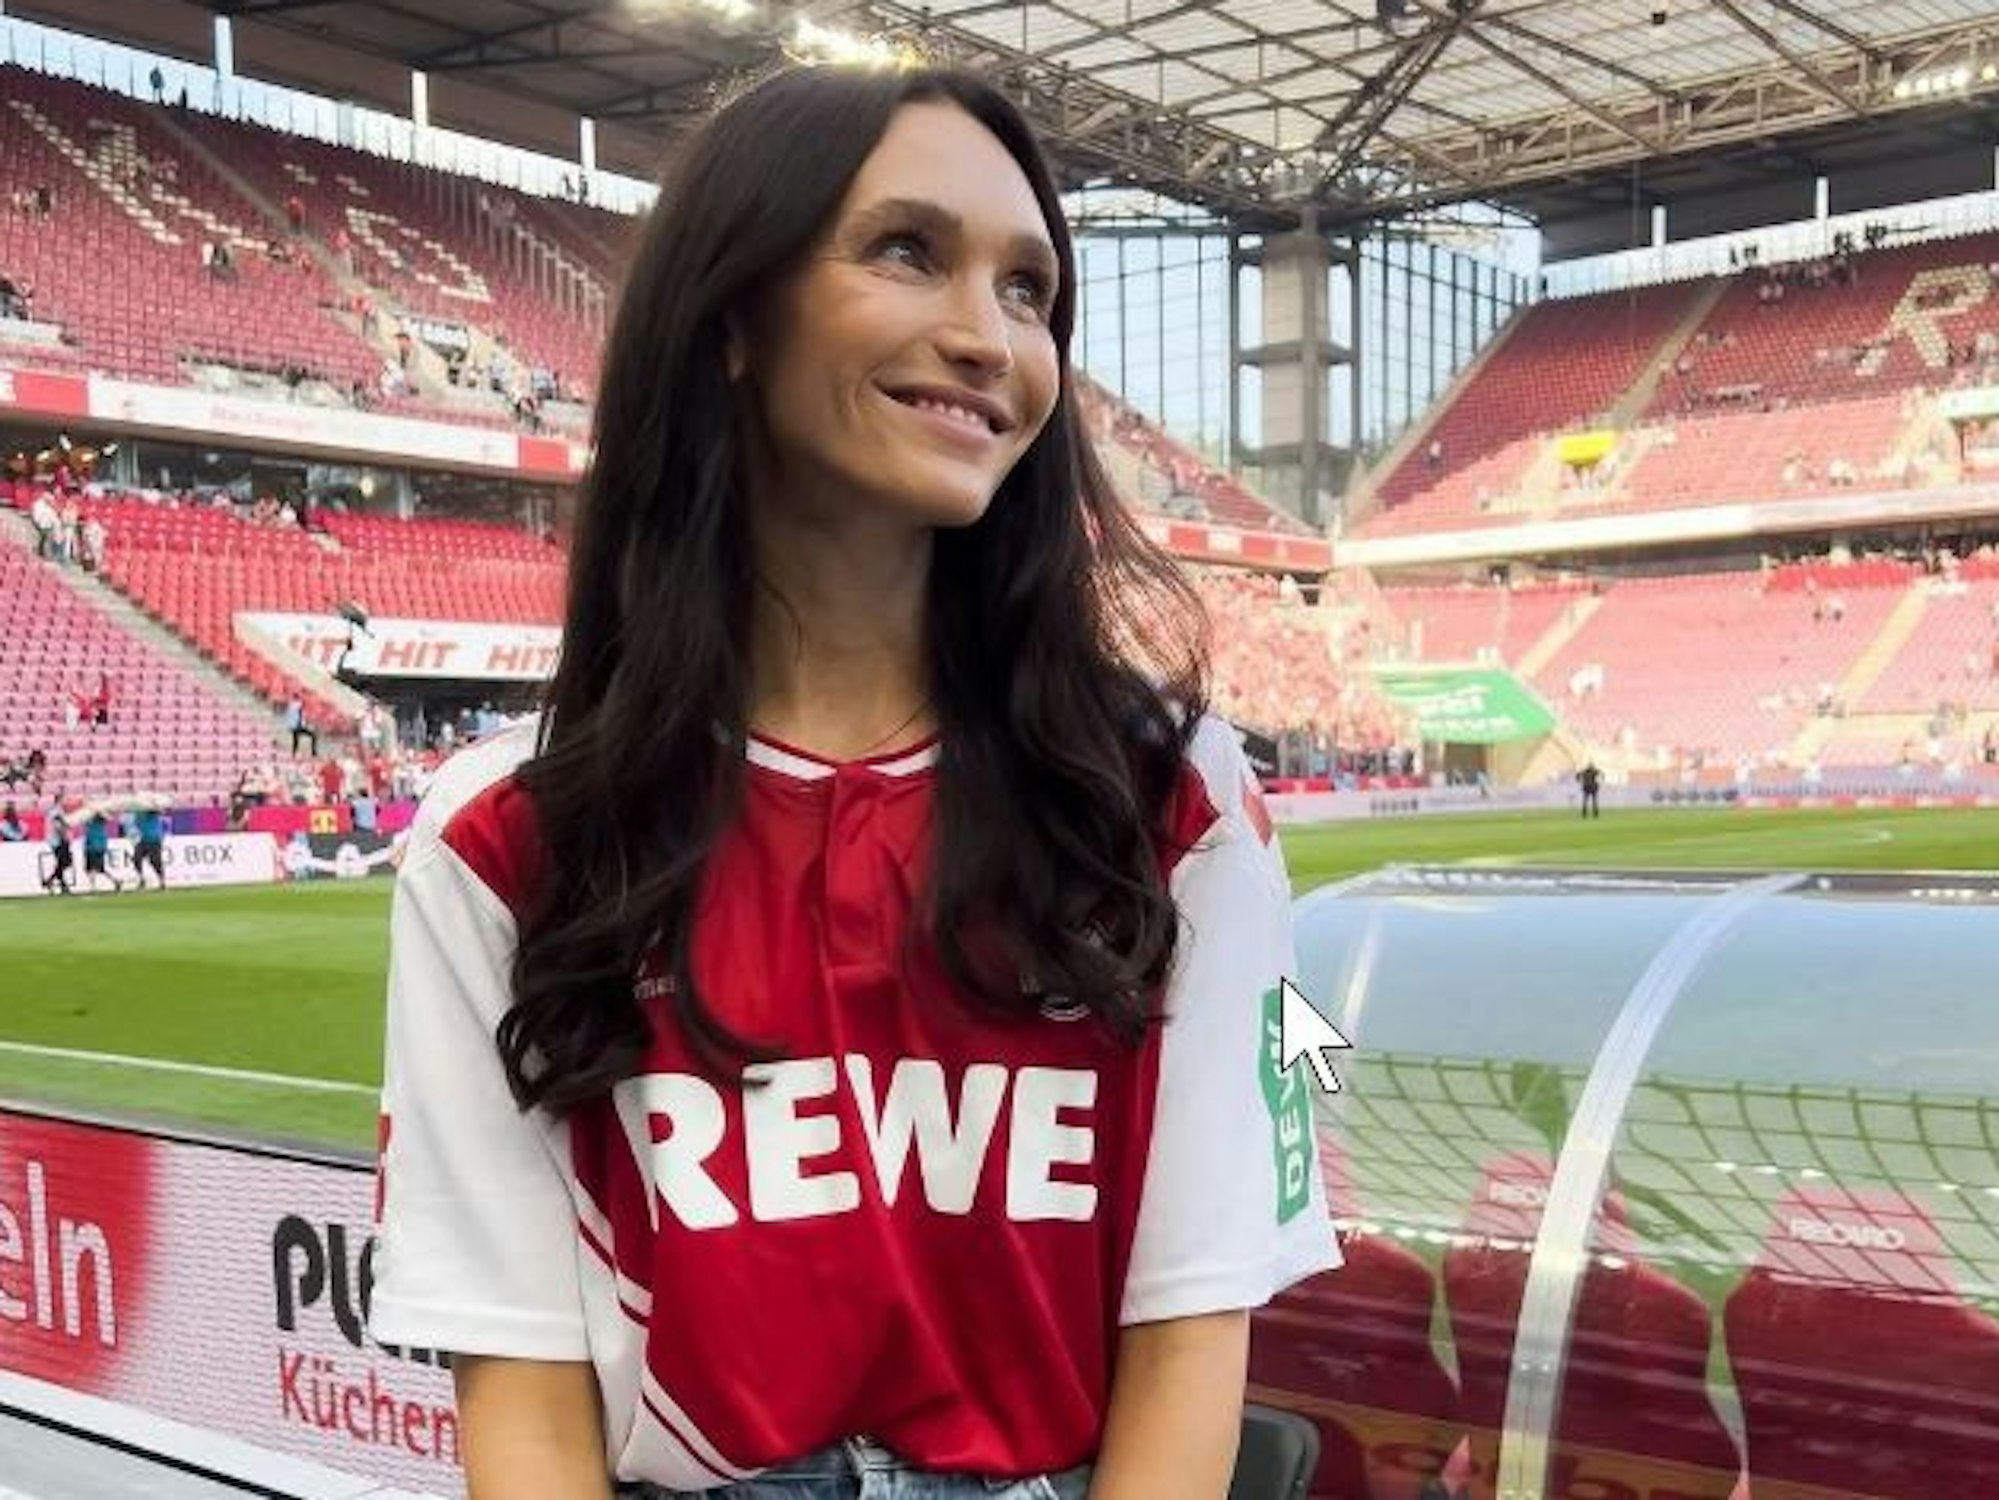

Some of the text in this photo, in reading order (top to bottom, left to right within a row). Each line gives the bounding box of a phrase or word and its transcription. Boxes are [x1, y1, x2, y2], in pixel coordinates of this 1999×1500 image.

[377, 640, 459, 668] HIT
[184, 844, 233, 868] BOX
[613, 1052, 1098, 1233] REWE
[278, 1346, 460, 1464] Küchen
